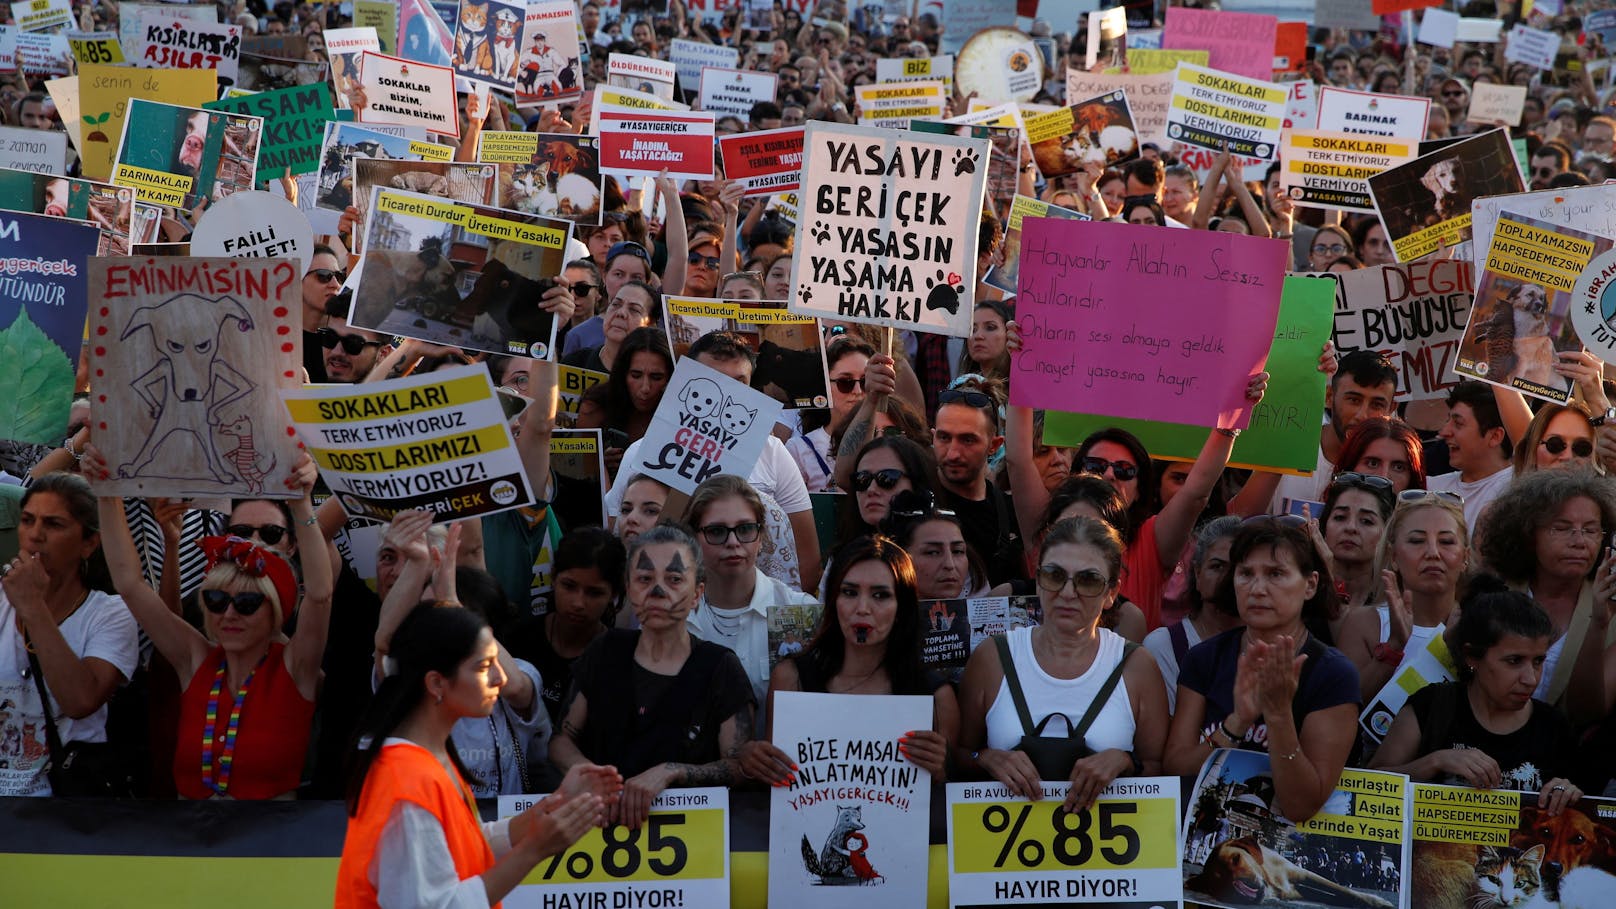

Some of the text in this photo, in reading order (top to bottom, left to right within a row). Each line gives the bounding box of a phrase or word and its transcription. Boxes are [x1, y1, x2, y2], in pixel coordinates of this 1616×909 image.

[73, 40, 113, 63] %85
[907, 61, 928, 75] BİZ
[92, 75, 160, 92] senin de
[378, 77, 431, 93] SOKAKLAR
[725, 85, 752, 93] SOKAK
[875, 87, 925, 99] SOKAKLARI
[1198, 74, 1266, 99] SOKAKLARI
[1191, 87, 1267, 113] TERK ETMİYORUZ
[371, 103, 446, 123] CANLAR BİZİM!
[872, 107, 931, 119] DOSTLARIMIZI
[1184, 99, 1266, 127] DOSTLARIMIZI
[1345, 112, 1397, 125] BARINAK
[484, 133, 538, 141] TOPLAYAMAZSIN
[620, 121, 688, 134] #YASAYIGERİÇEK
[1184, 114, 1263, 141] VERMİYORUZ!
[410, 143, 449, 158] Kısırlaştır
[483, 142, 537, 152] HAPSEDEMEZSİN
[633, 138, 671, 151] İNADINA
[1183, 130, 1253, 153] #YASAYIGRİÇEK
[1312, 138, 1387, 154] SOKAKLARI
[482, 152, 530, 162] ÖLDÜREMEZSİN
[619, 149, 684, 162] YAŞATACAĞIZ!
[826, 141, 942, 181] YASAYI
[1307, 151, 1390, 167] TERK ETMİYORUZ
[119, 168, 191, 191] BARINAKLAR
[147, 192, 182, 204] KAMPI
[895, 190, 951, 227] ÇEK
[381, 196, 466, 224] Ticareti Durdur
[1563, 203, 1593, 221] your
[224, 225, 276, 253] FAİLİ
[467, 216, 561, 246] Üretimi Yasakla
[1499, 222, 1591, 256] TOPLAYAMAZSIN
[837, 226, 953, 264] YAŞASIN
[1395, 235, 1420, 250] DOĞAL
[1025, 236, 1112, 279] Hayvanlar
[1400, 247, 1422, 261] ÖLÜM
[1493, 240, 1585, 273] HAPSEDEMEZSİN
[811, 256, 914, 293] YAŞAMA
[1489, 256, 1573, 290] ÖLDÜREMEZSİN
[671, 302, 735, 317] Ticareti Durdur
[837, 292, 921, 323] HAKKI
[1122, 322, 1171, 356] olmaya
[1181, 335, 1225, 359] geldik
[1513, 379, 1567, 401] #YasayıGeriÇek
[318, 385, 449, 421] SOKAKLARI
[321, 411, 466, 444] TERK ETMİYORUZ
[678, 411, 738, 450] YASAYI
[328, 434, 482, 473] DOSTLARIMIZI
[558, 441, 595, 451] Yasakla
[674, 427, 725, 463] GERİ
[341, 460, 488, 500] VERMİYORUZ!
[925, 633, 960, 646] TOPLAMA
[923, 650, 966, 664] DUR DE !!!
[797, 736, 905, 763] BİZE MASAL
[788, 762, 918, 795] ANLATMAYIN!
[1337, 776, 1400, 797] ısırlaştır
[665, 794, 708, 808] İSTİYOR
[964, 786, 982, 799] BİR
[1116, 783, 1160, 796] İSTİYOR
[1417, 788, 1518, 806] TOPLAYAMAZSIN
[1359, 799, 1400, 818] Aşılat
[1417, 807, 1517, 825] HAPSEDEMEZSİN
[982, 802, 1140, 868] %85
[1358, 824, 1400, 842] Yaşat
[1416, 824, 1507, 844] ÖLDÜREMEZSİN
[543, 814, 688, 881] %85
[543, 886, 684, 909] HAYIR DİYOR!
[995, 875, 1138, 899] HAYIR DİYOR!
